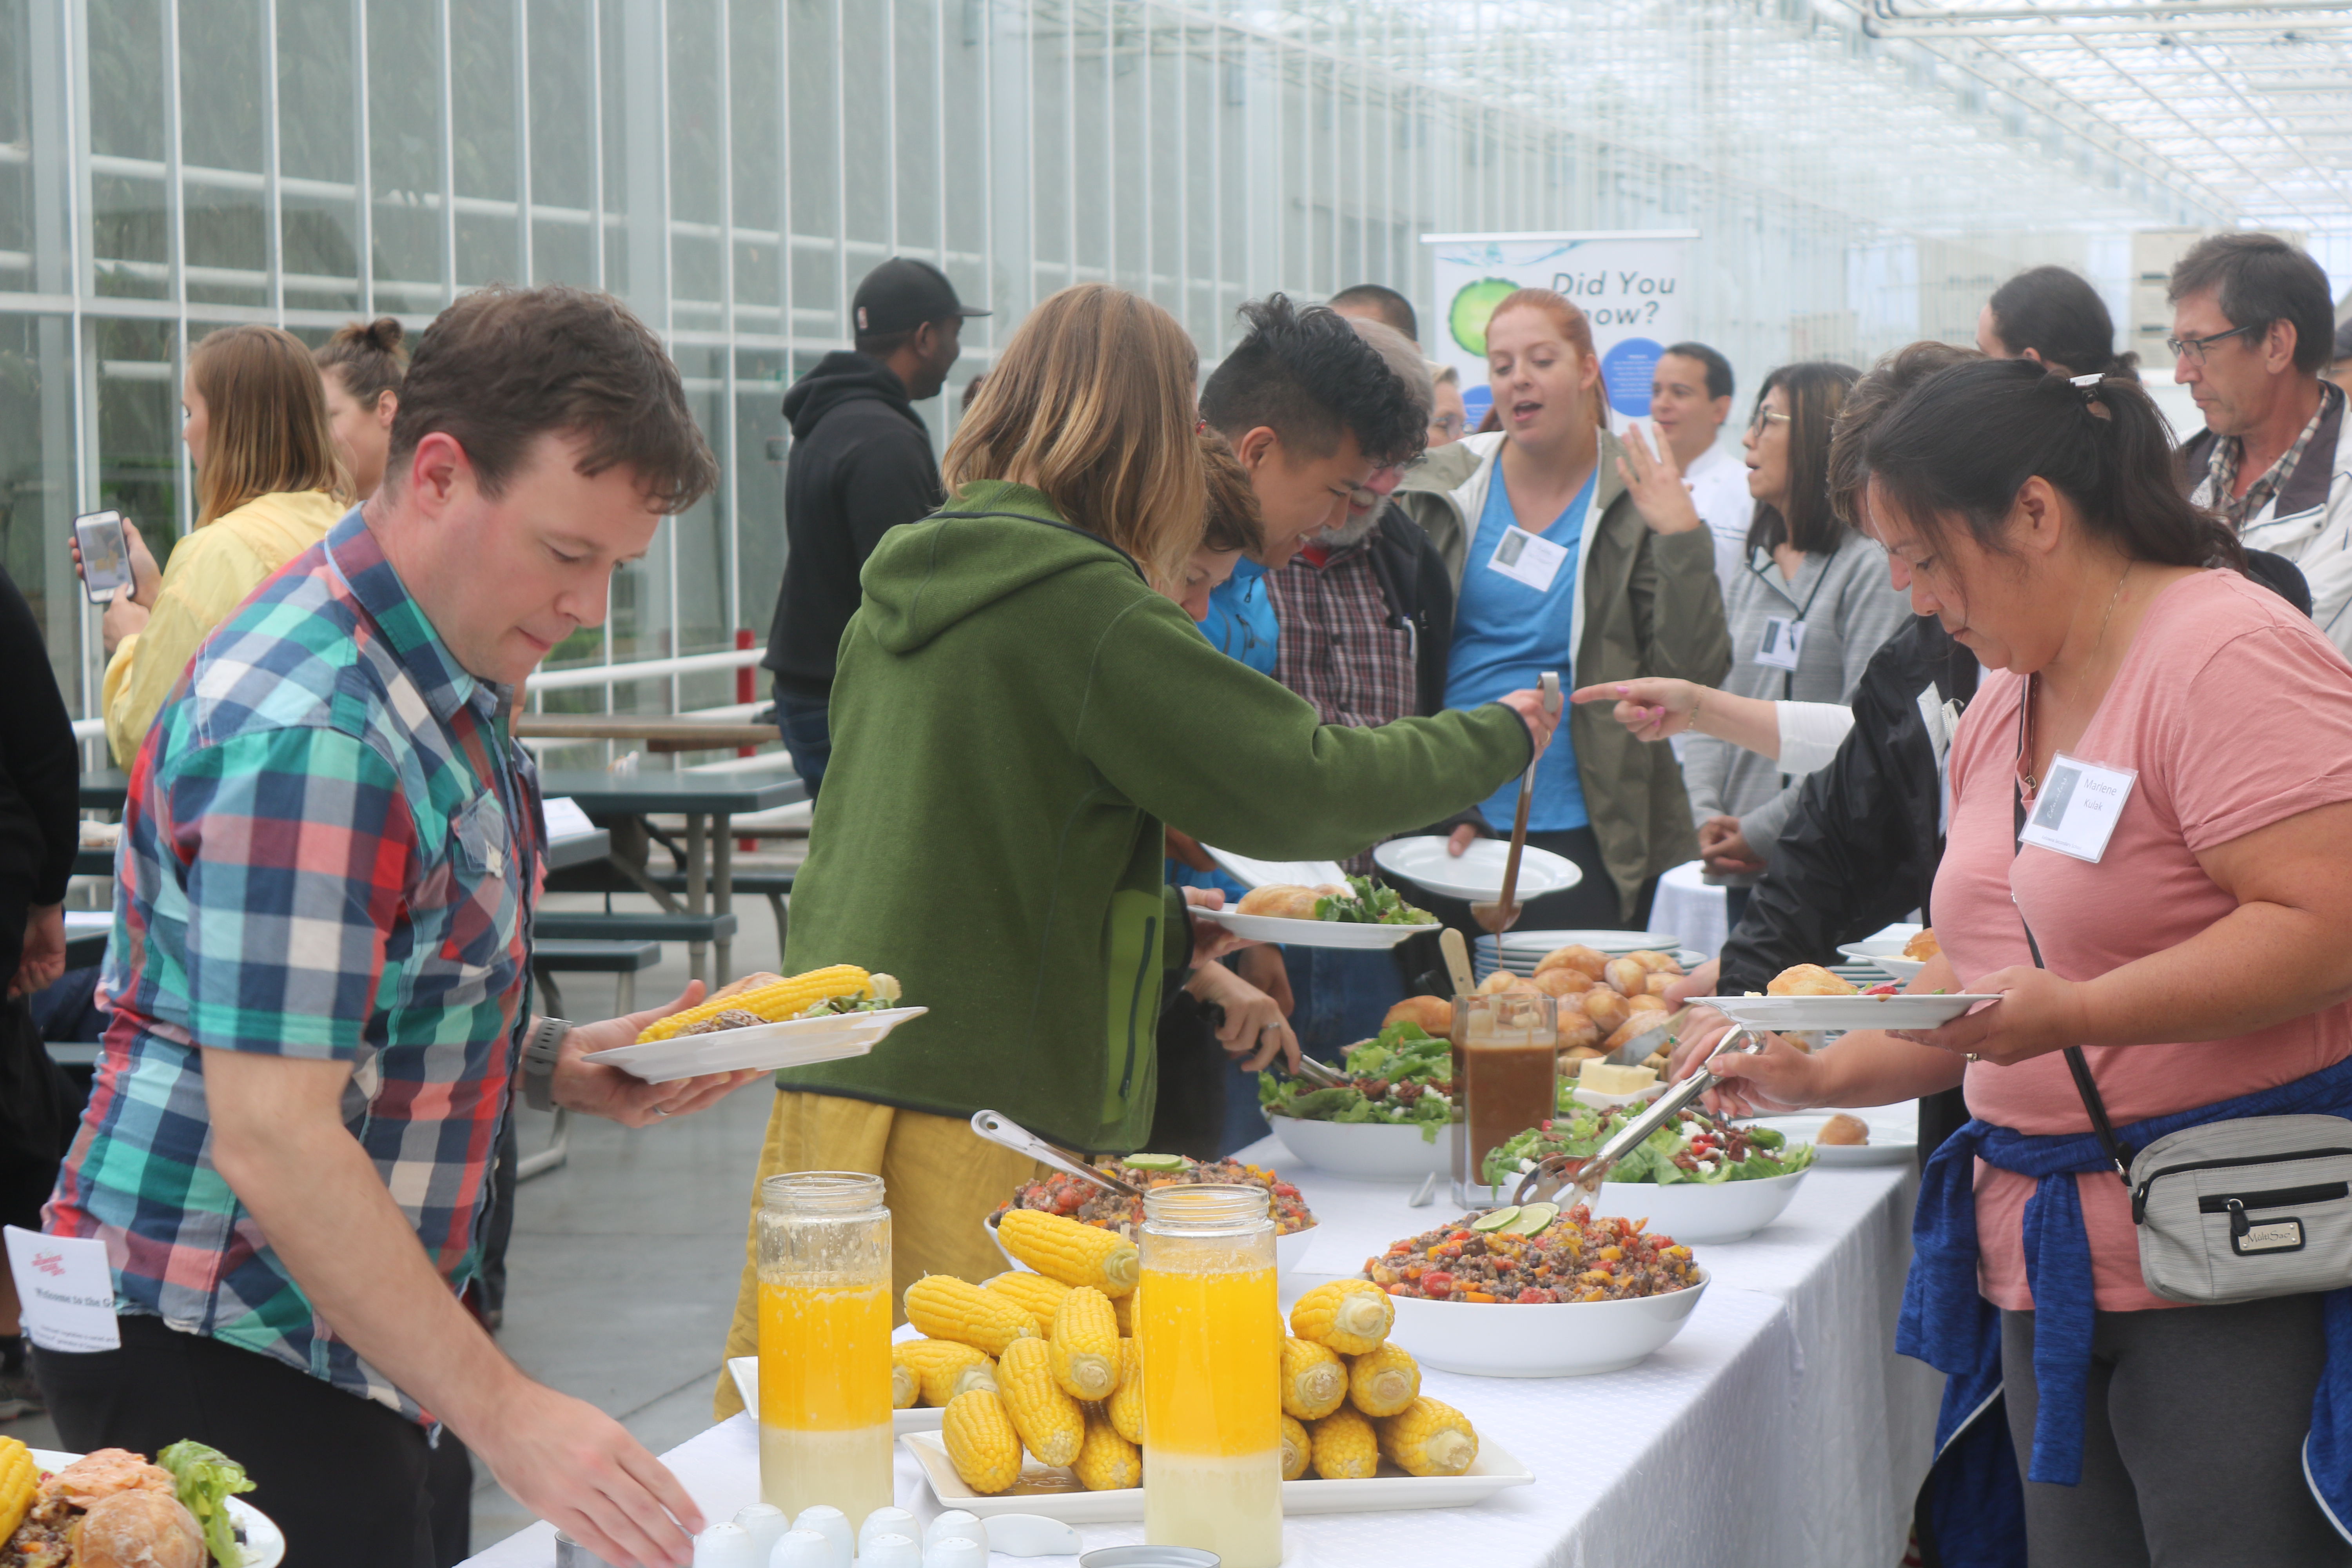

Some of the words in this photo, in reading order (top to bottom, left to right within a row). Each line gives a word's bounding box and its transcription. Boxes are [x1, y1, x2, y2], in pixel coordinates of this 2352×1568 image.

[1552, 270, 1607, 295] Did
[1619, 271, 1676, 294] You
[1582, 301, 1660, 325] now?
[2047, 777, 2067, 818] Educators
[2083, 779, 2117, 796] Marlene
[2083, 798, 2103, 811] Kulak
[2247, 1230, 2290, 1243] MultiSac
